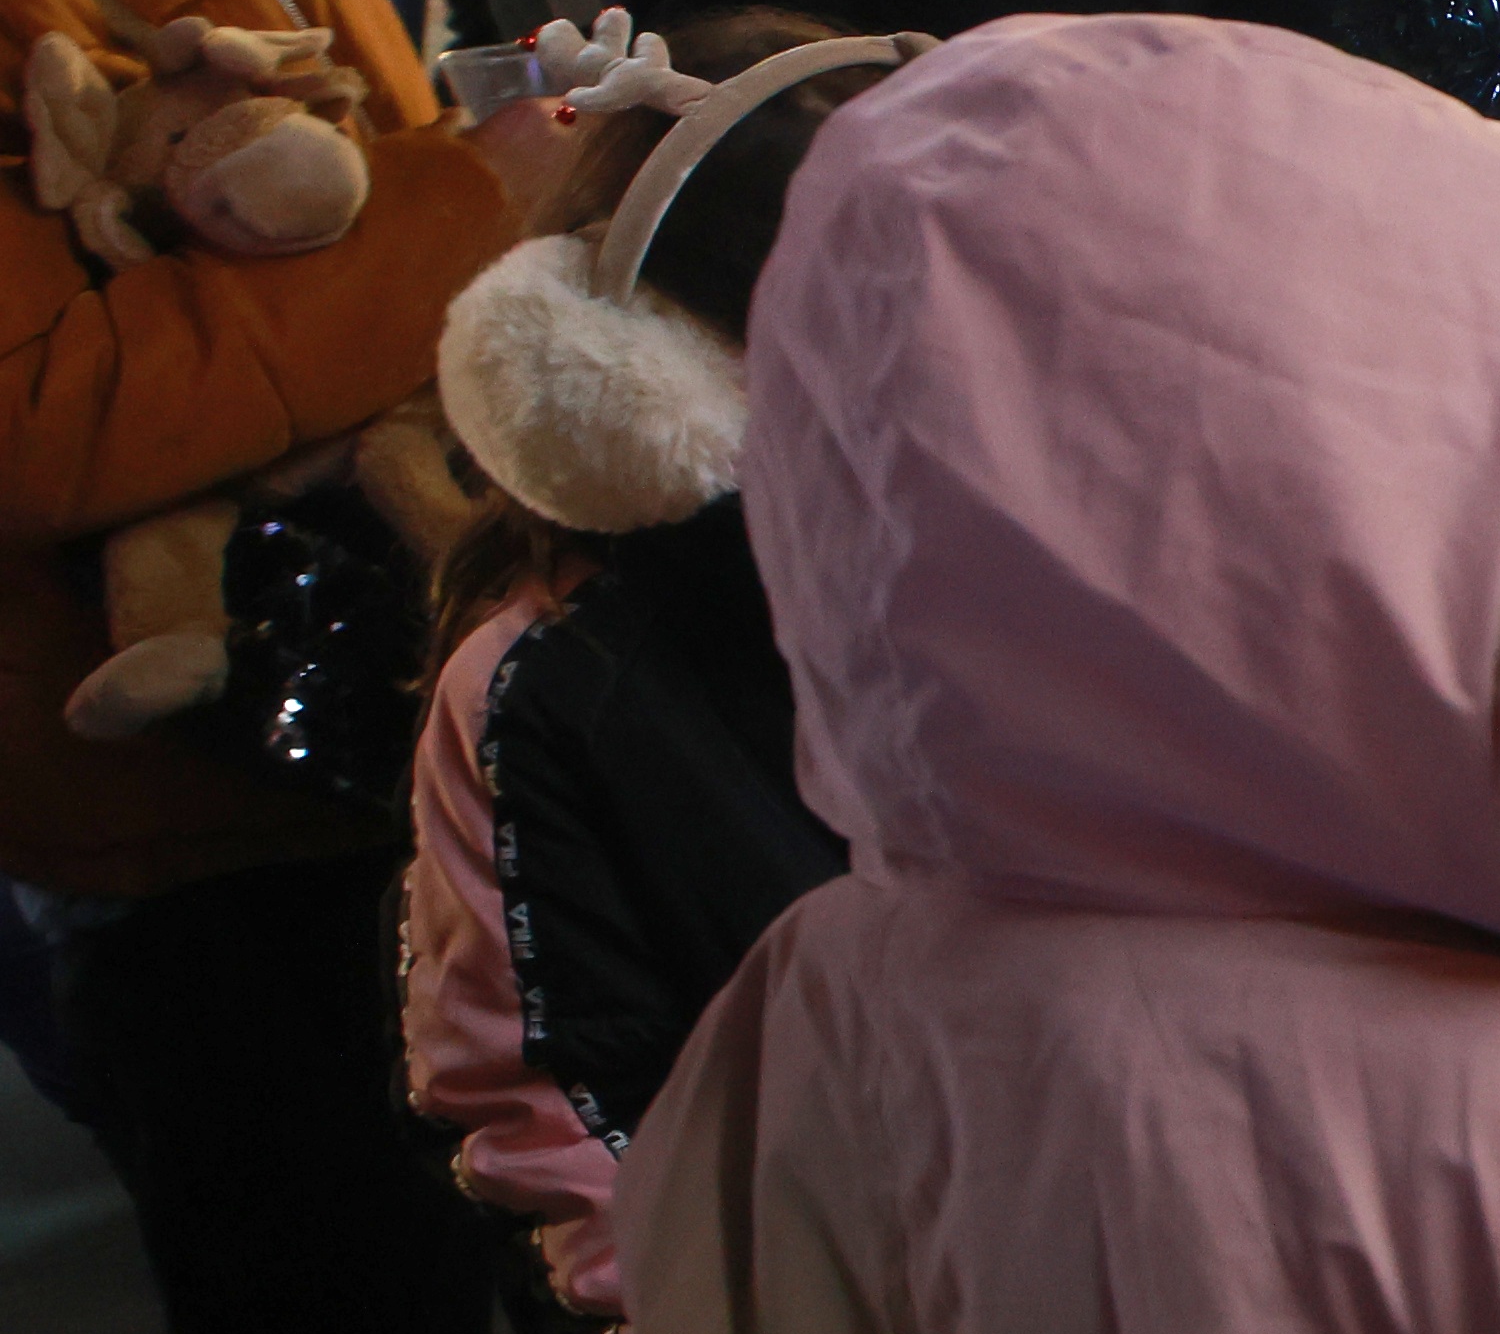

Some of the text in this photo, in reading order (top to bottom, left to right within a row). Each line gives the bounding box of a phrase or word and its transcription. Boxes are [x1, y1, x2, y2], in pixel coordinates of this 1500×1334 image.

[496, 821, 520, 878] FILA
[507, 901, 536, 959] FILA
[524, 985, 550, 1040] FILA
